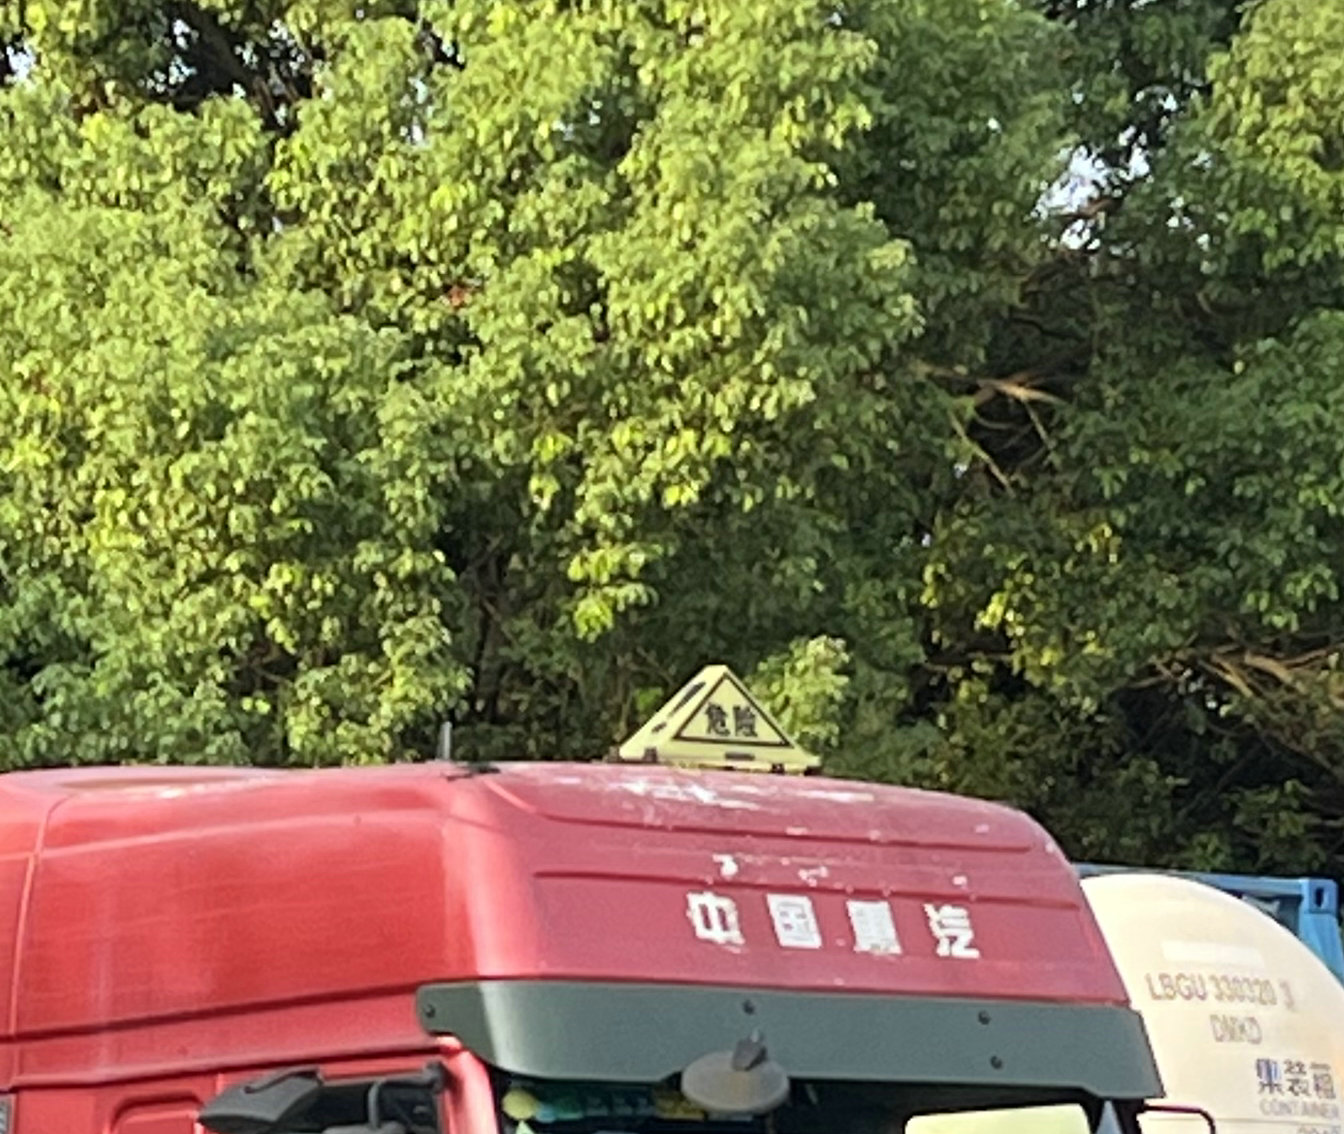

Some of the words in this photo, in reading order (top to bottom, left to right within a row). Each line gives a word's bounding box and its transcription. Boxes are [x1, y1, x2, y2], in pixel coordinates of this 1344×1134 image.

[705, 702, 758, 738] 危险
[1256, 1057, 1337, 1100] 集装箱
